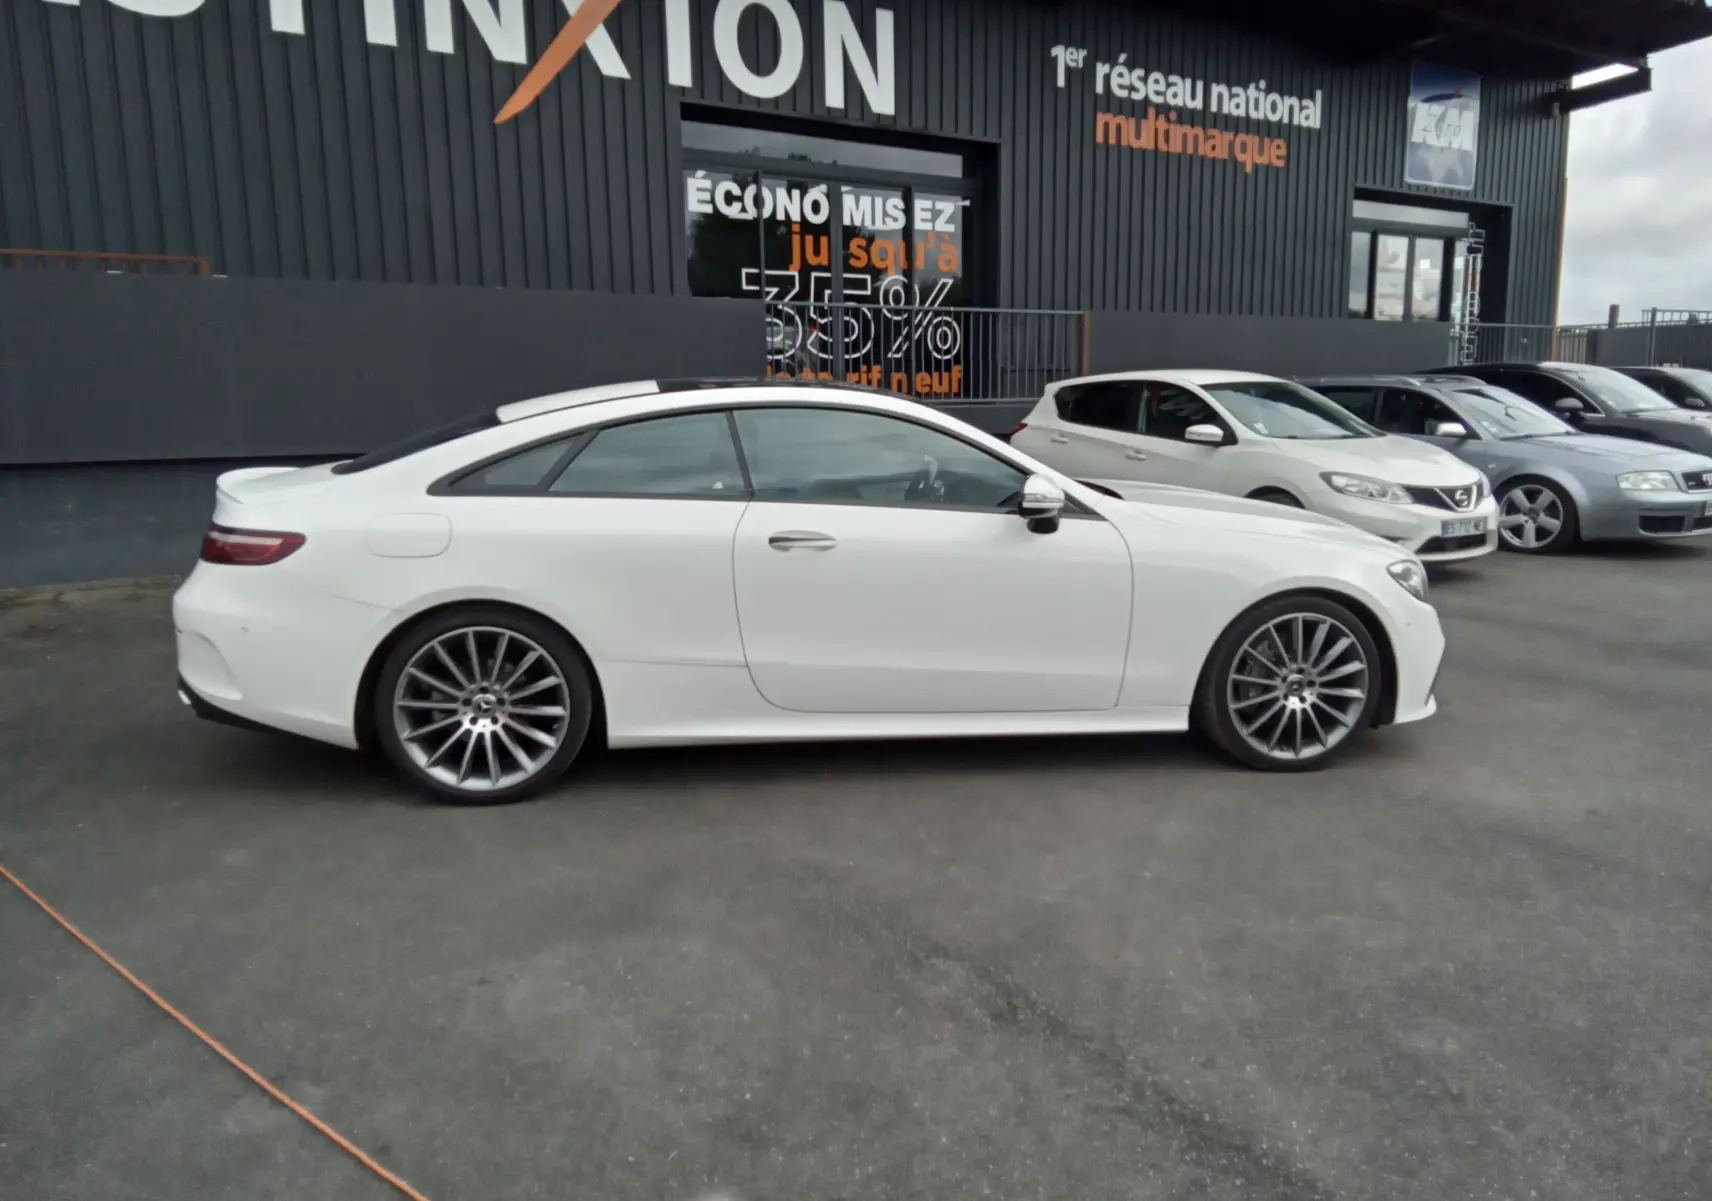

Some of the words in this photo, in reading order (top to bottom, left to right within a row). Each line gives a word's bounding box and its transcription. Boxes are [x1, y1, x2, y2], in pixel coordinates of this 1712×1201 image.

[42, 0, 896, 124] NXION
[1050, 44, 1088, 88] 1er
[1095, 53, 1204, 110] réseau
[1210, 79, 1323, 129] national
[1095, 106, 1288, 173] multimarque
[741, 268, 962, 360] 35%
[889, 364, 962, 394] neuf
